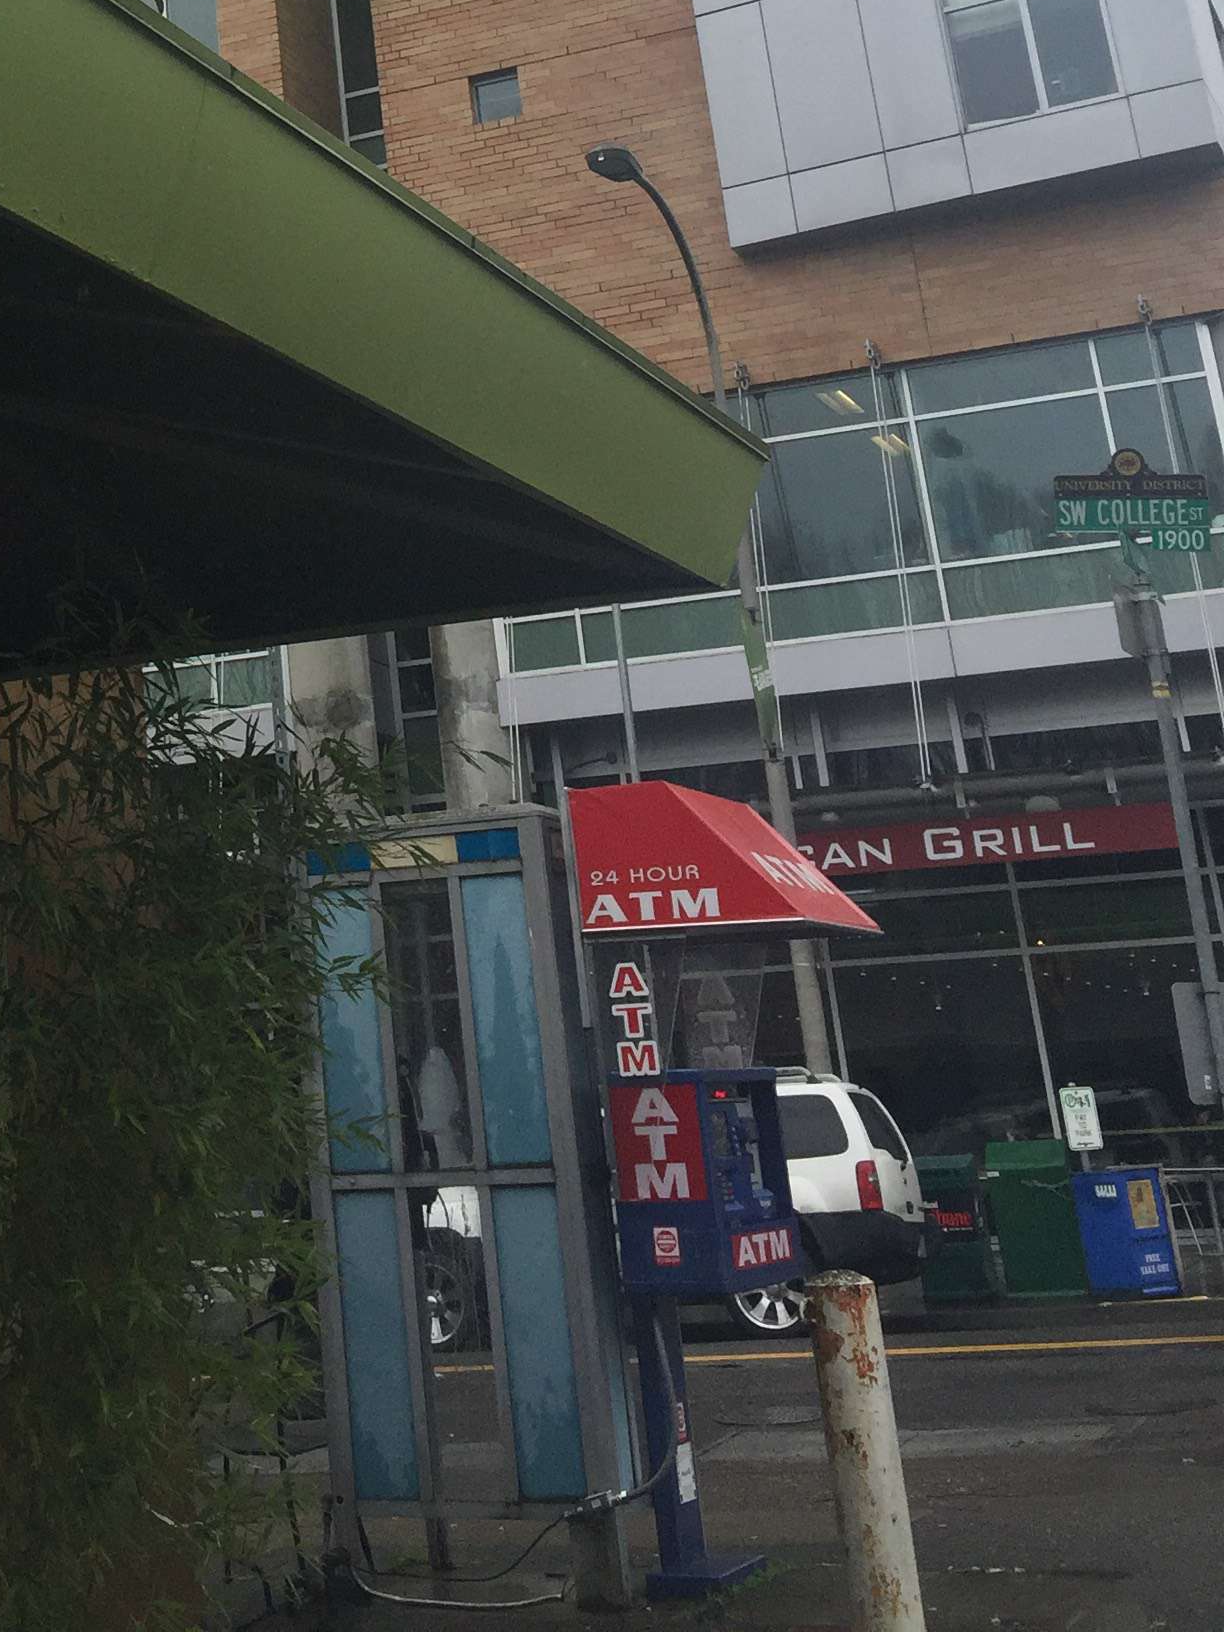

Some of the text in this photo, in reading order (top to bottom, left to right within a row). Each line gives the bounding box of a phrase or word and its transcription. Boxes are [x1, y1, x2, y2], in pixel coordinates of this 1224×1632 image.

[1055, 479, 1204, 491] UNIVERSITY DISTRICT
[1058, 498, 1204, 526] SW COLLEGE ST
[1157, 529, 1205, 551] 1900
[922, 822, 1096, 861] GRILL
[590, 864, 700, 886] 24 HOUR
[751, 851, 835, 895] ATM
[585, 887, 721, 925] ATM
[609, 962, 661, 1077] ATM
[632, 1088, 690, 1199] ATM
[738, 1229, 791, 1267] ATM
